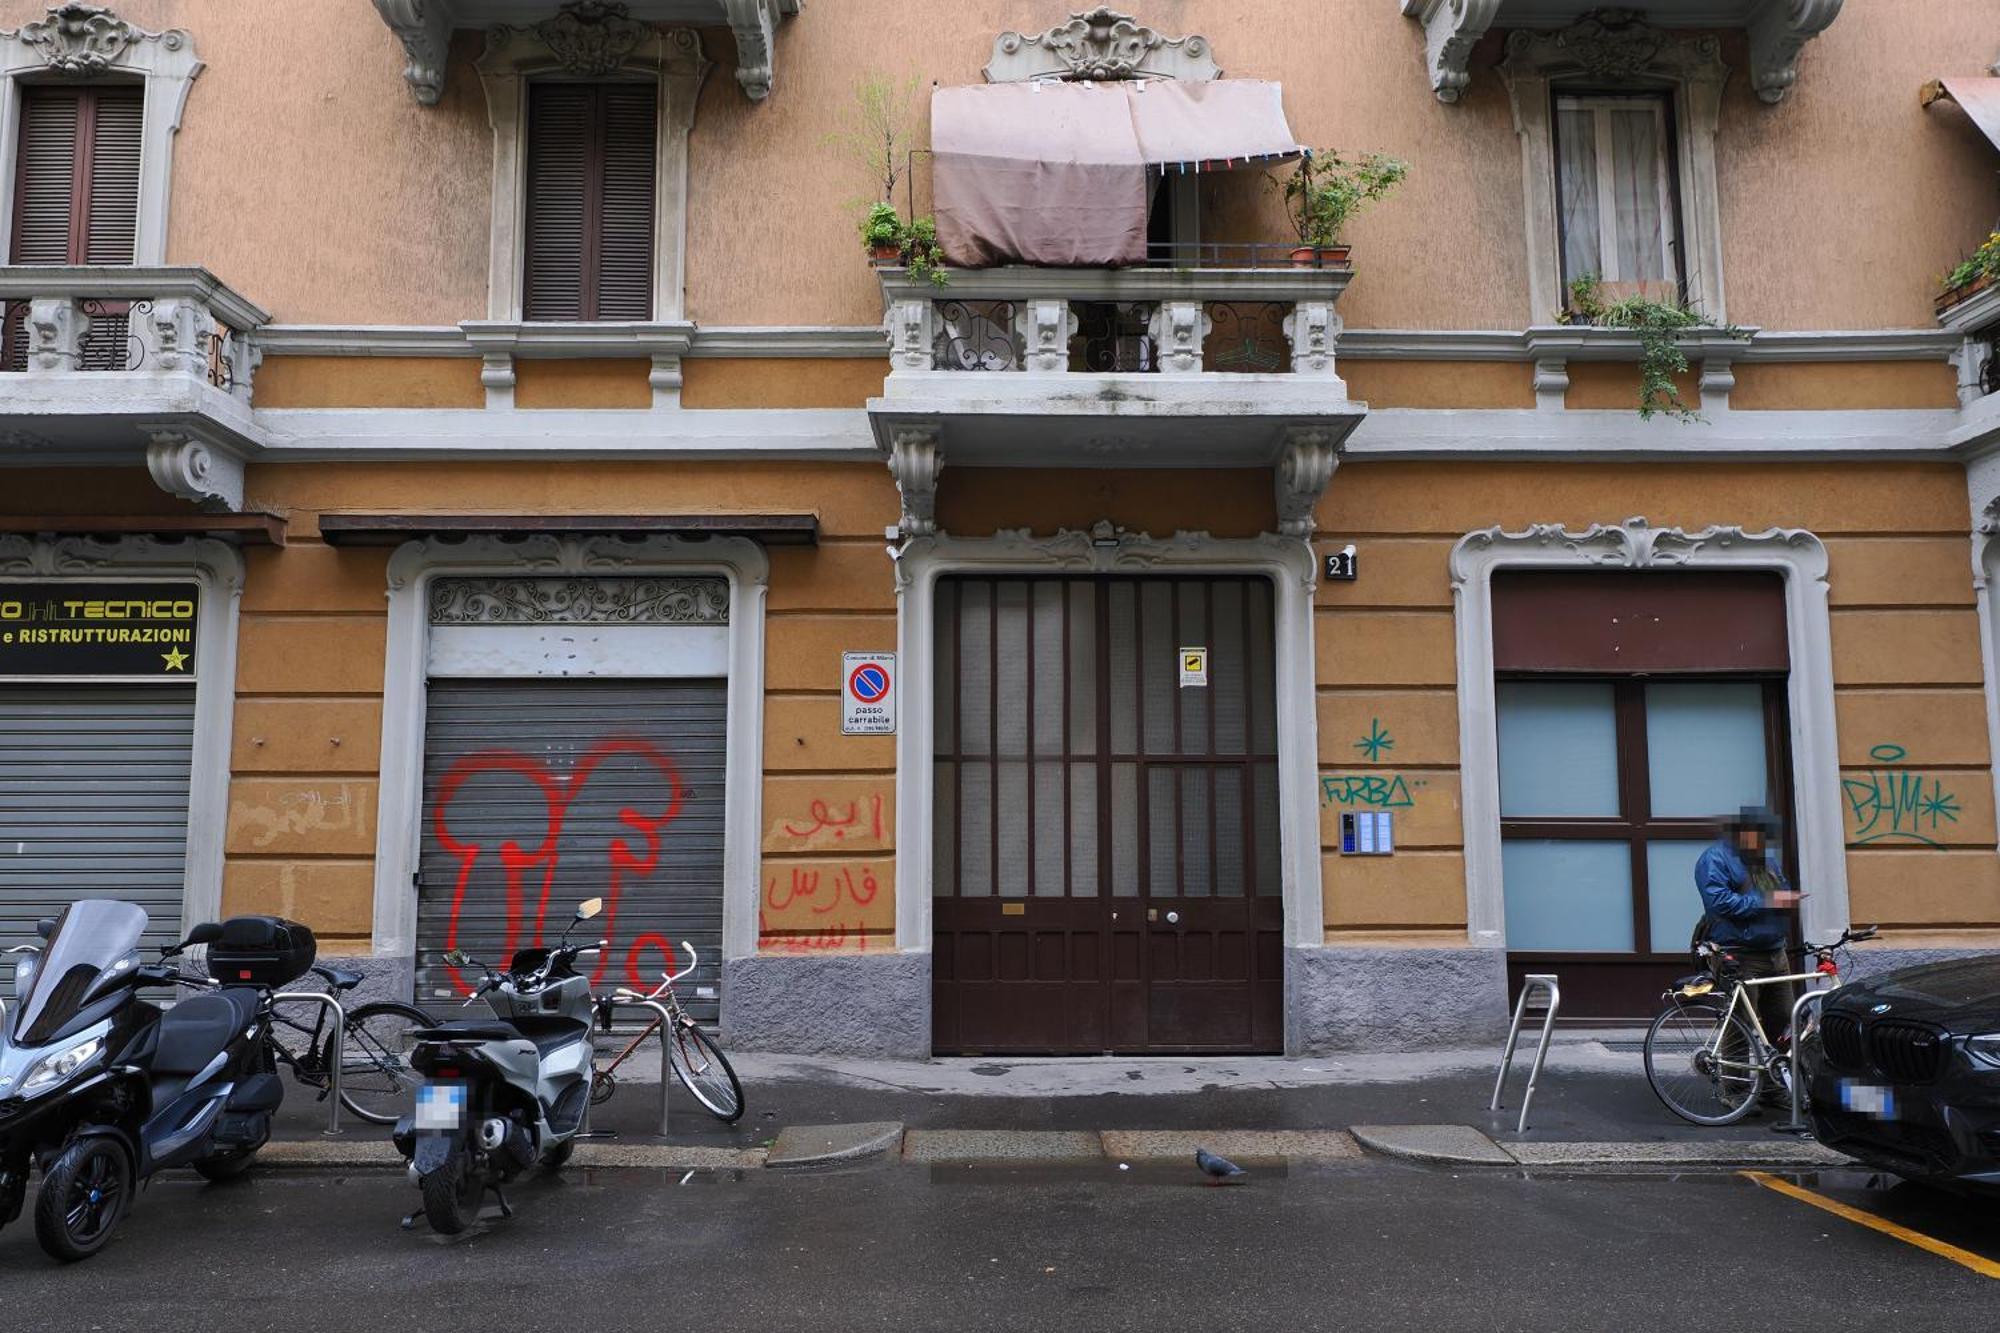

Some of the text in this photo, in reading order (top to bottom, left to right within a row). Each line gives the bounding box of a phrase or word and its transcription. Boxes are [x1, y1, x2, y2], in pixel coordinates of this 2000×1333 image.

[1328, 556, 1353, 576] 21
[3, 629, 191, 644] e RISTRUTTURAZIONI
[855, 707, 884, 716] passo
[848, 715, 890, 724] carrabile
